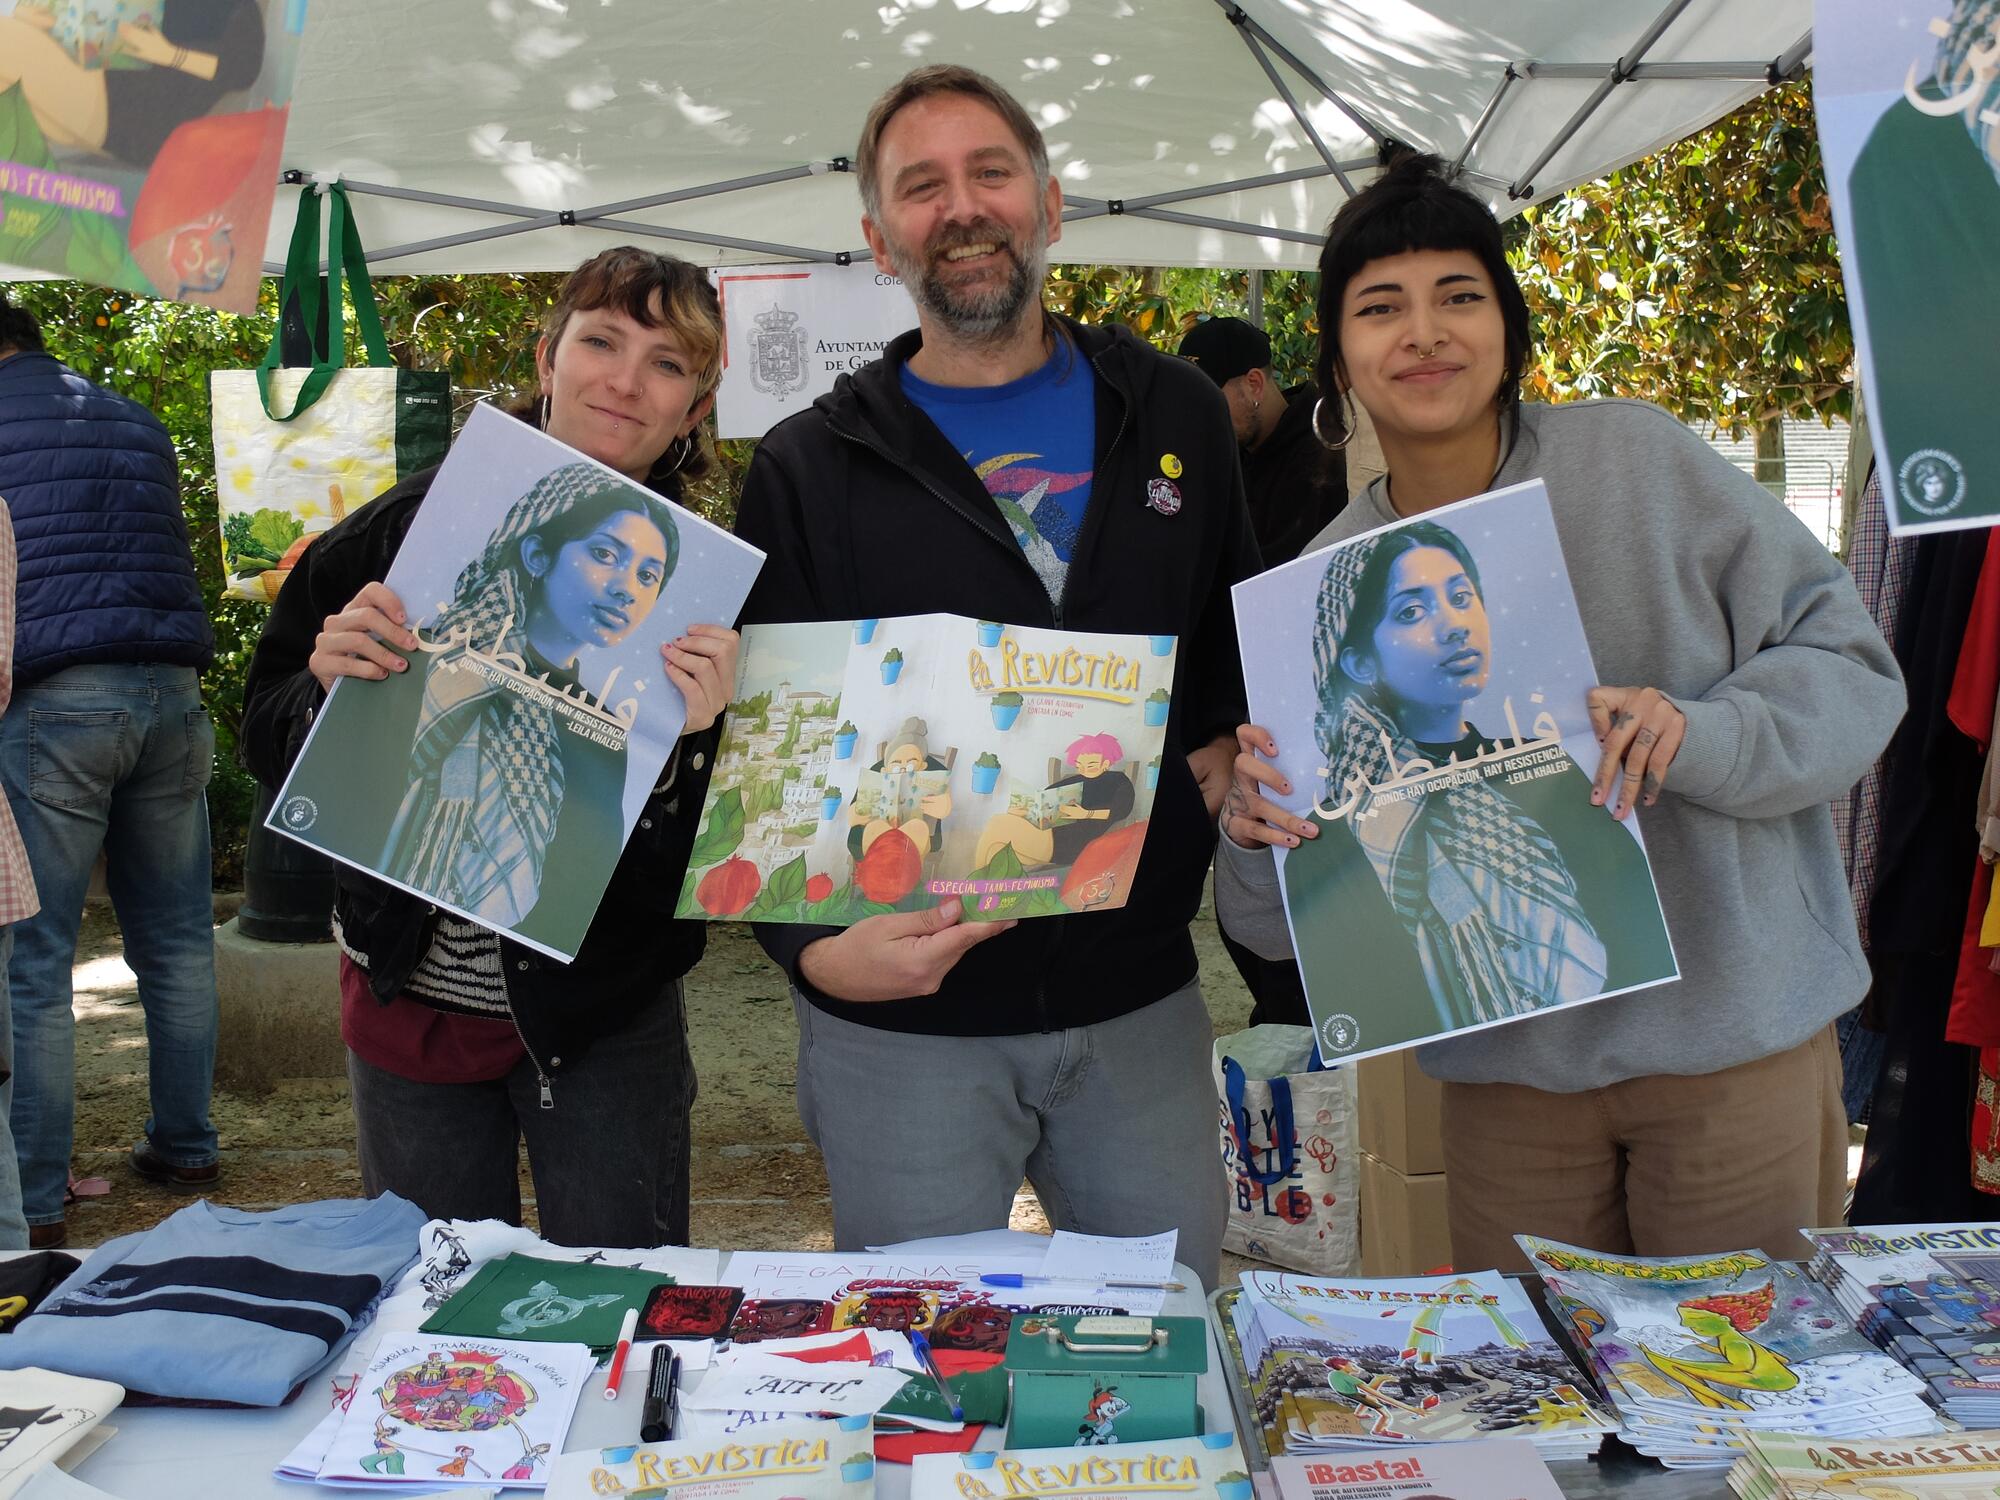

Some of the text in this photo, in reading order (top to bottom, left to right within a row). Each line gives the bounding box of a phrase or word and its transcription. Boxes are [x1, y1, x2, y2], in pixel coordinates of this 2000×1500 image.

[816, 340, 893, 354] AYUNTAM
[459, 656, 490, 679] DONDE
[489, 669, 507, 687] HAY
[556, 699, 575, 718] HAY
[574, 709, 627, 742] RESISTENCIA
[1373, 788, 1407, 809] DONDE
[1406, 784, 1427, 800] HAY
[1483, 762, 1503, 777] HAY
[1503, 747, 1567, 773] RESISTENCIA
[754, 1264, 981, 1278] PEGATINAS
[1828, 1443, 2000, 1470] REVÍSTI
[1304, 1457, 1425, 1486] ¡Basta!
